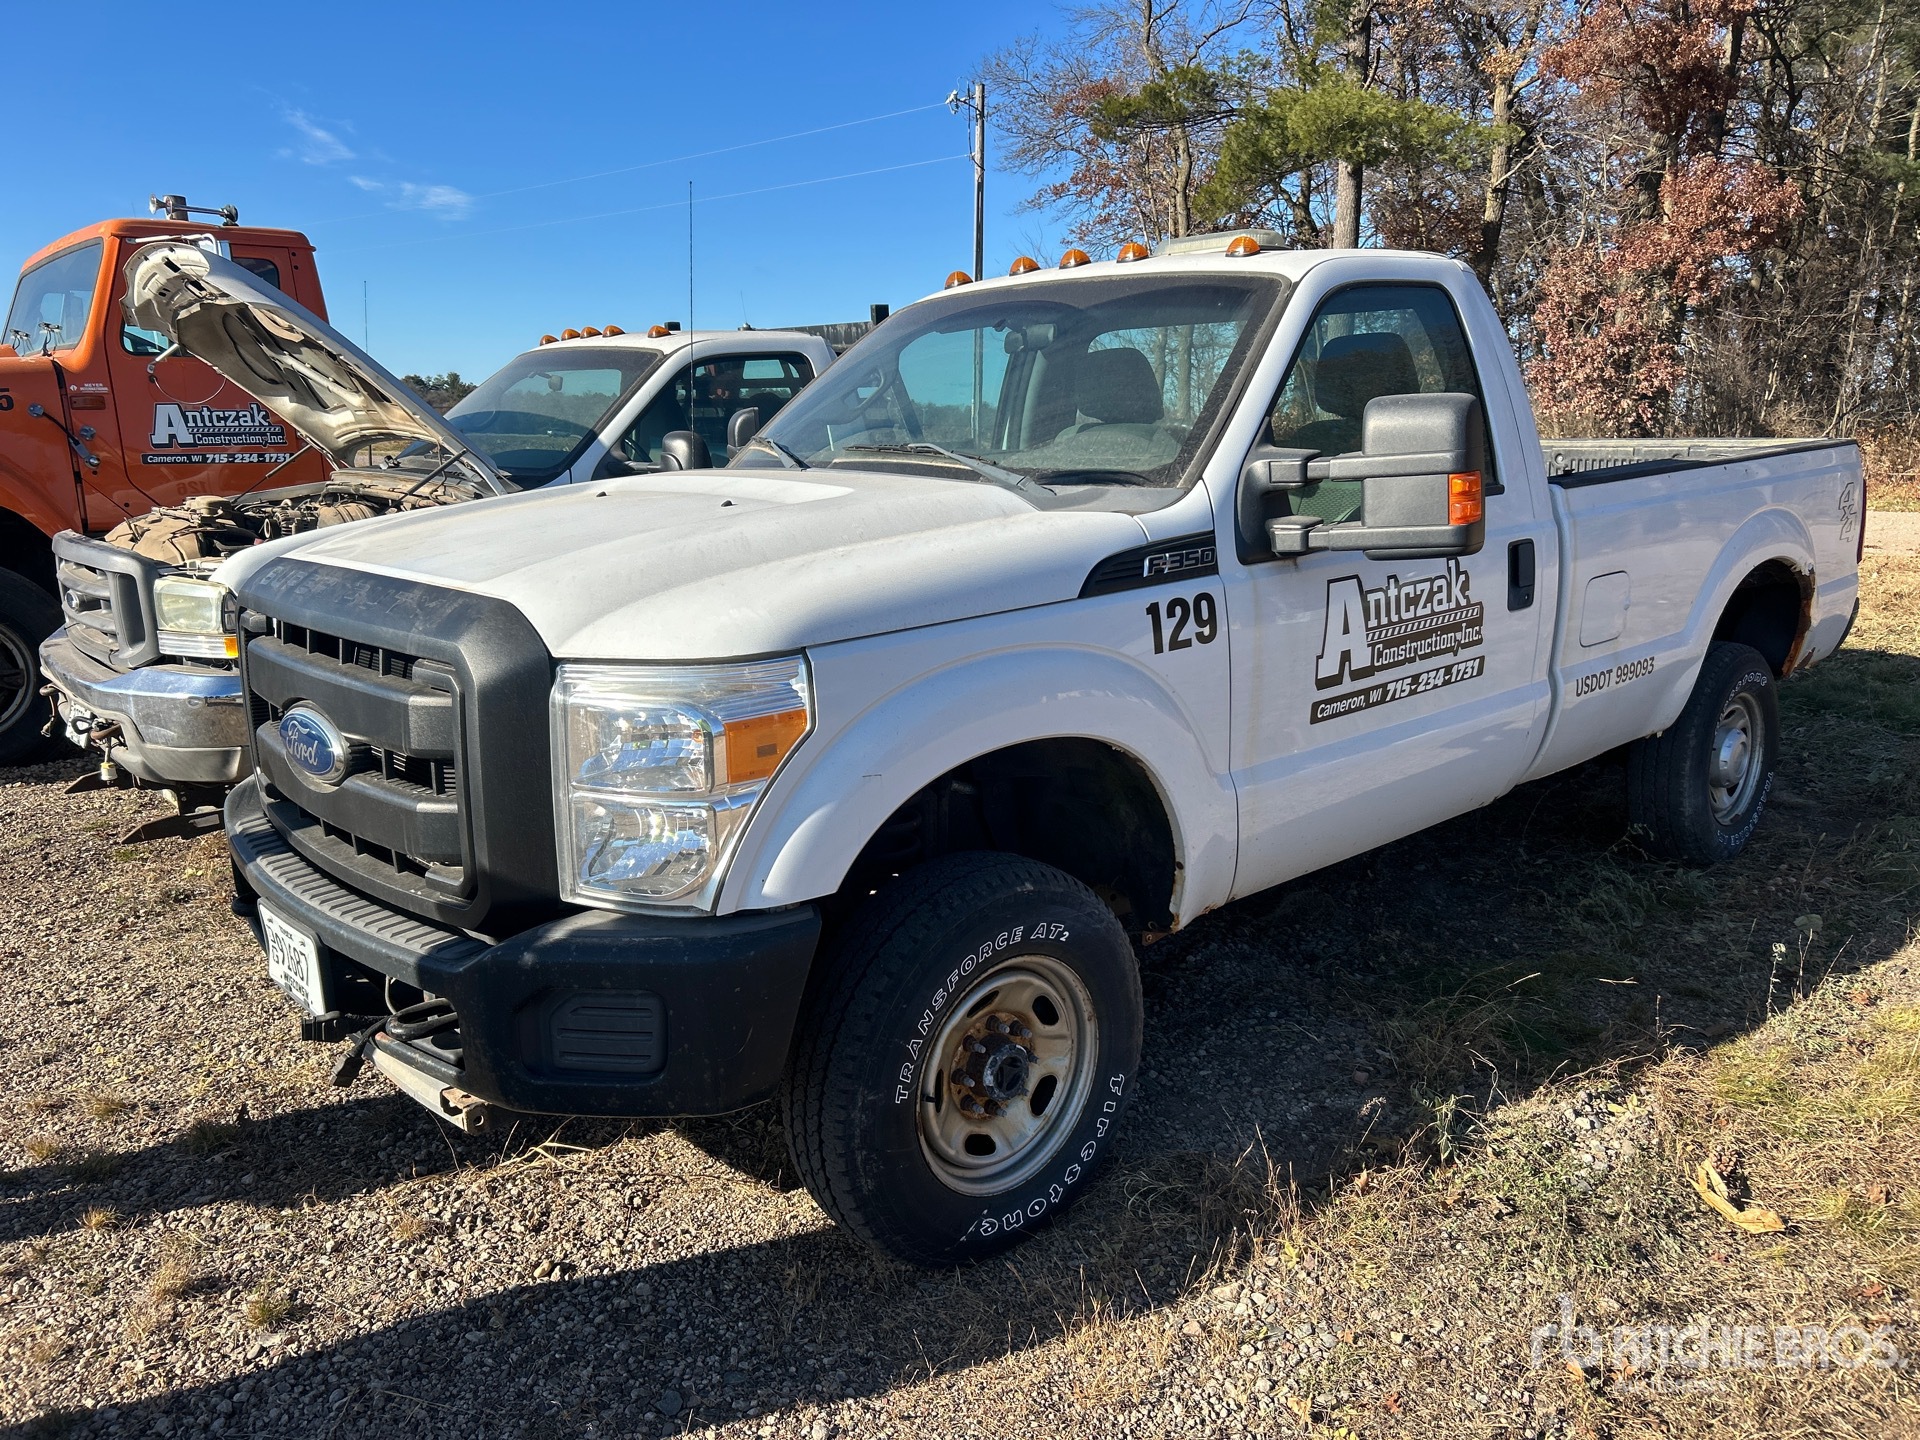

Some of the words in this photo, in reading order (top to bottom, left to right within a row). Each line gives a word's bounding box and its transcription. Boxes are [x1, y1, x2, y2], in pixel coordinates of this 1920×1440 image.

[152, 402, 269, 444] Antczak
[267, 433, 286, 444] Inc.
[147, 454, 189, 464] Cameron,
[206, 453, 290, 464] 715-234-1731
[1145, 591, 1218, 655] 129
[1317, 559, 1468, 679] Antczak
[1373, 628, 1460, 667] Construction,
[1460, 622, 1483, 645] Inc.
[1316, 693, 1366, 719] Cameron,
[1369, 687, 1383, 704] WI
[1385, 658, 1480, 702] 715-234-1731
[1575, 668, 1613, 697] USDOT
[1615, 656, 1655, 685] 999093
[286, 719, 320, 767] Ford
[895, 925, 1025, 1104] TRANSFORCE
[979, 1073, 1125, 1237] Firestone
